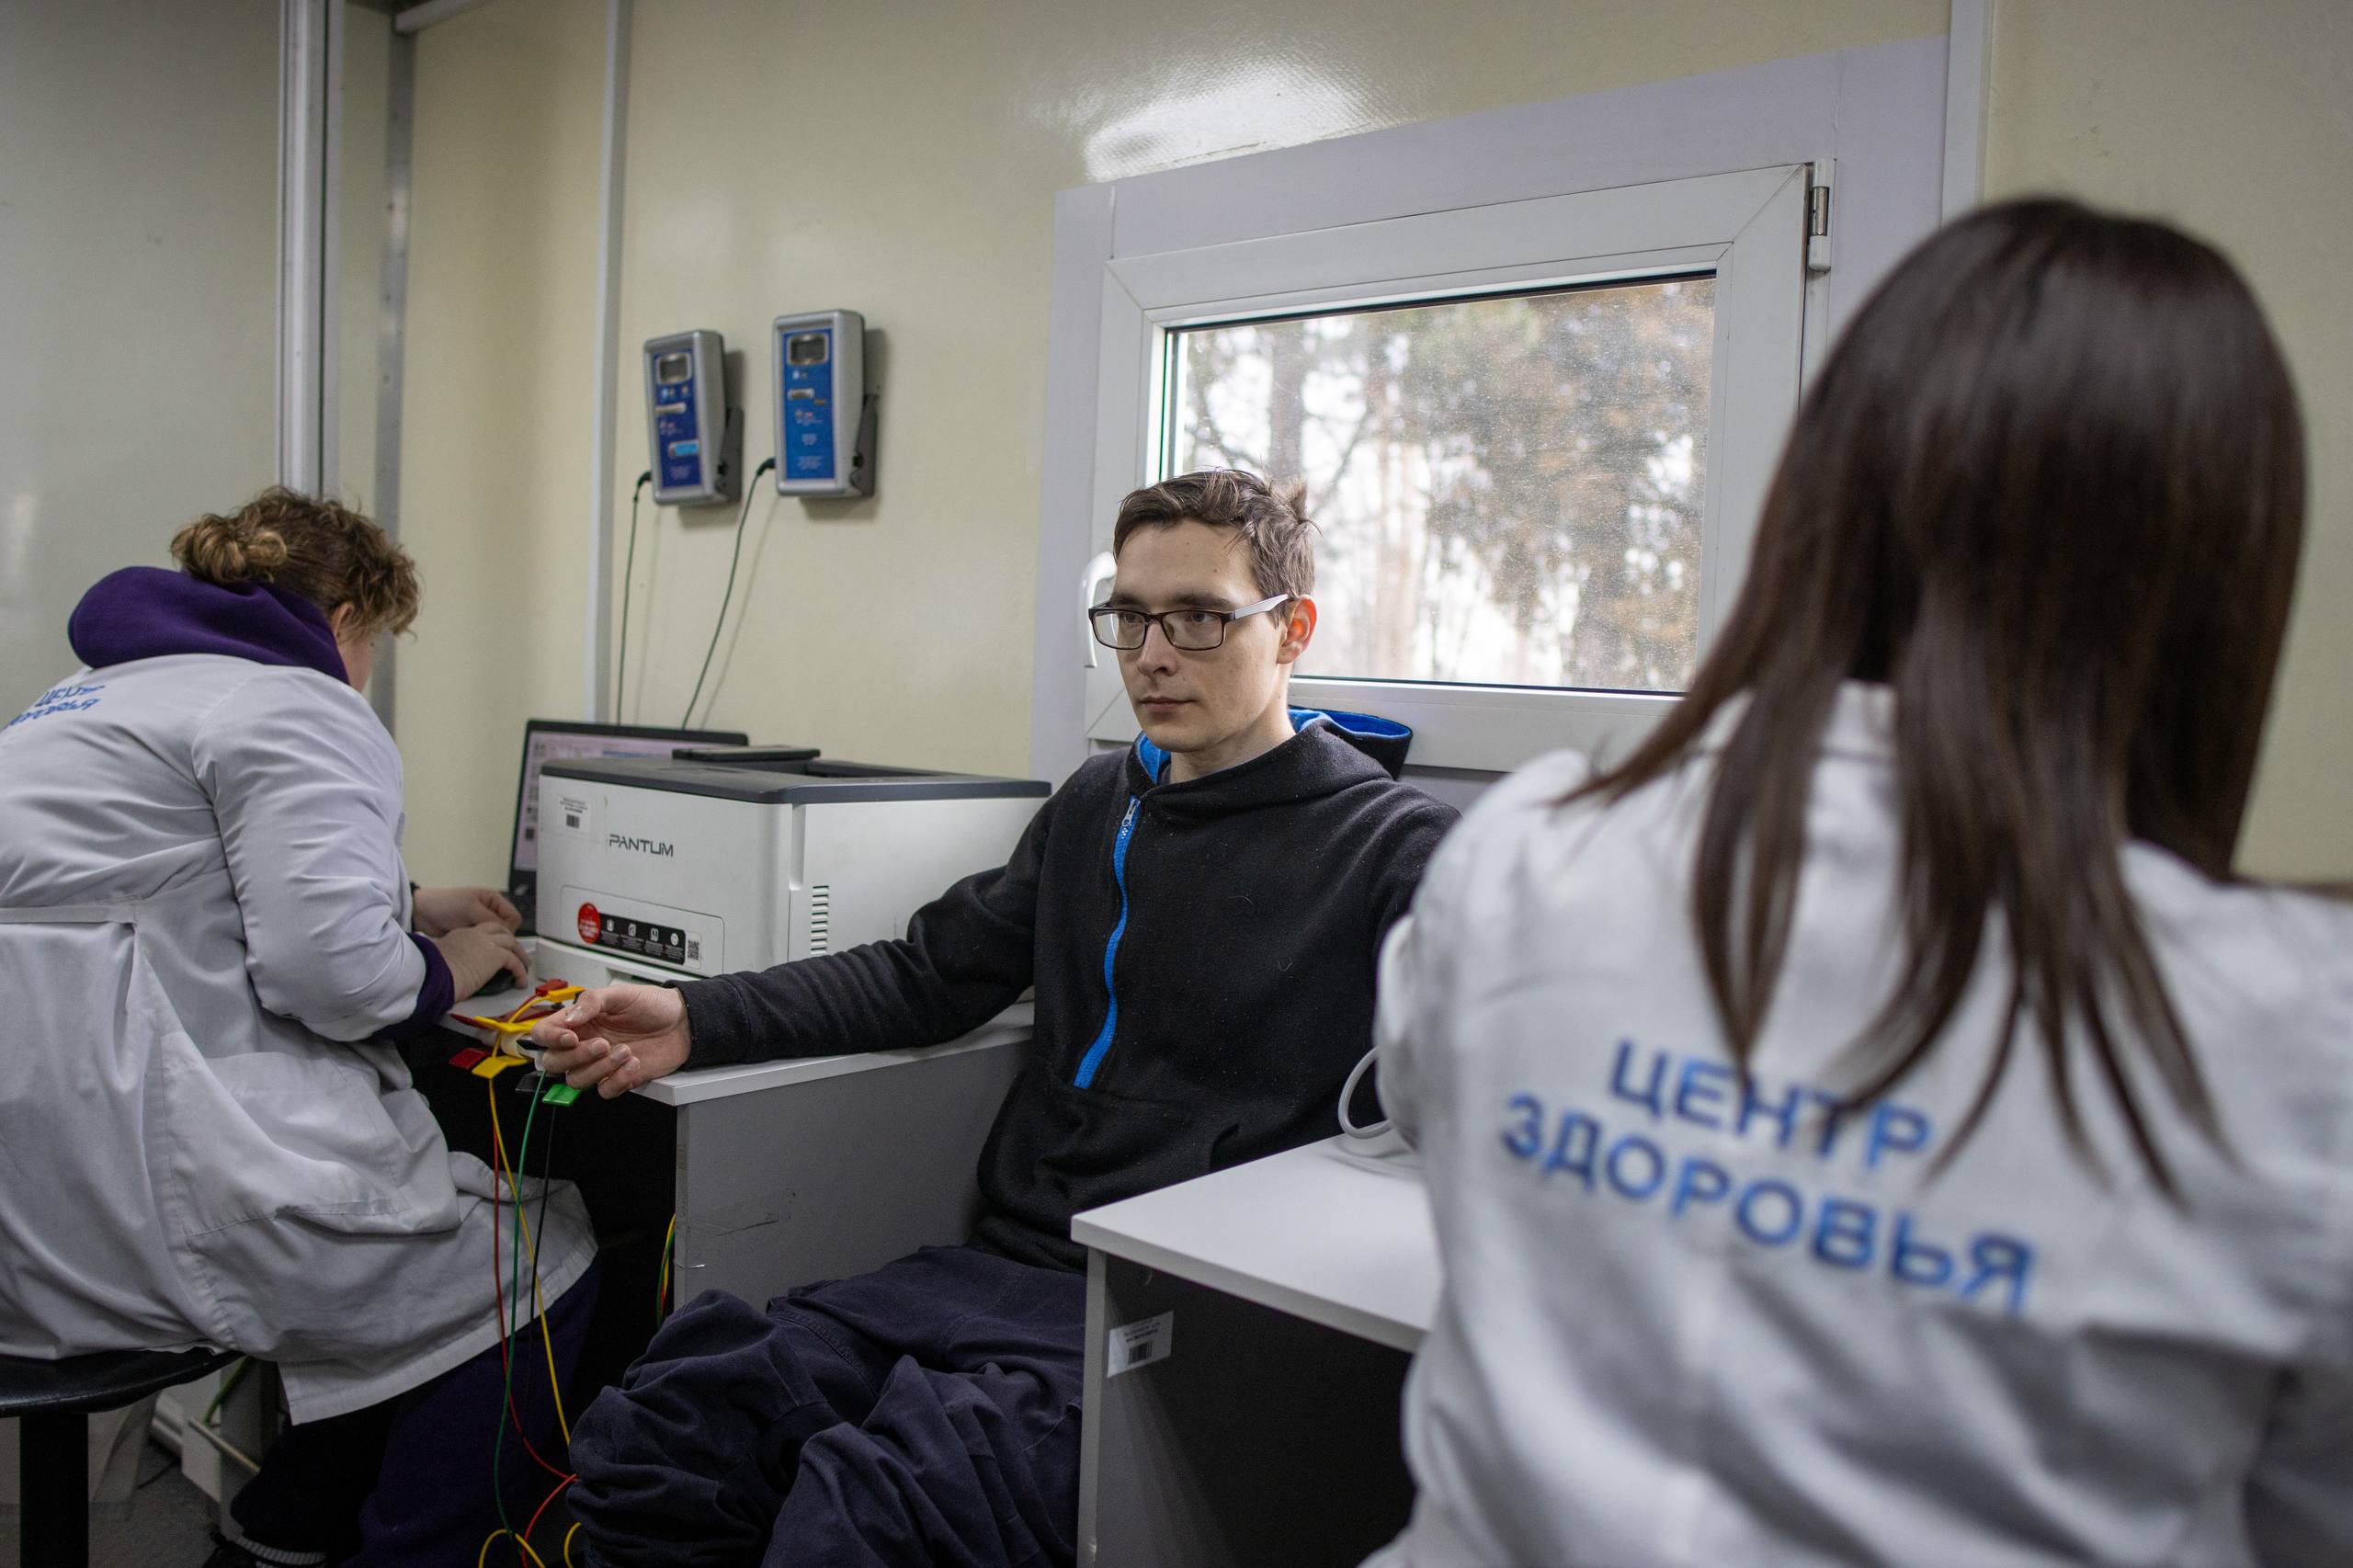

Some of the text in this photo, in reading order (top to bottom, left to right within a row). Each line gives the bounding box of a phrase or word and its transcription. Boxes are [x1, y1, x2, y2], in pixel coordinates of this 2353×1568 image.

[608, 834, 674, 858] PANTUM
[1609, 1040, 1932, 1172] ЦЕНТР
[1502, 1092, 2036, 1314] ЗДОРОВЬЯ
